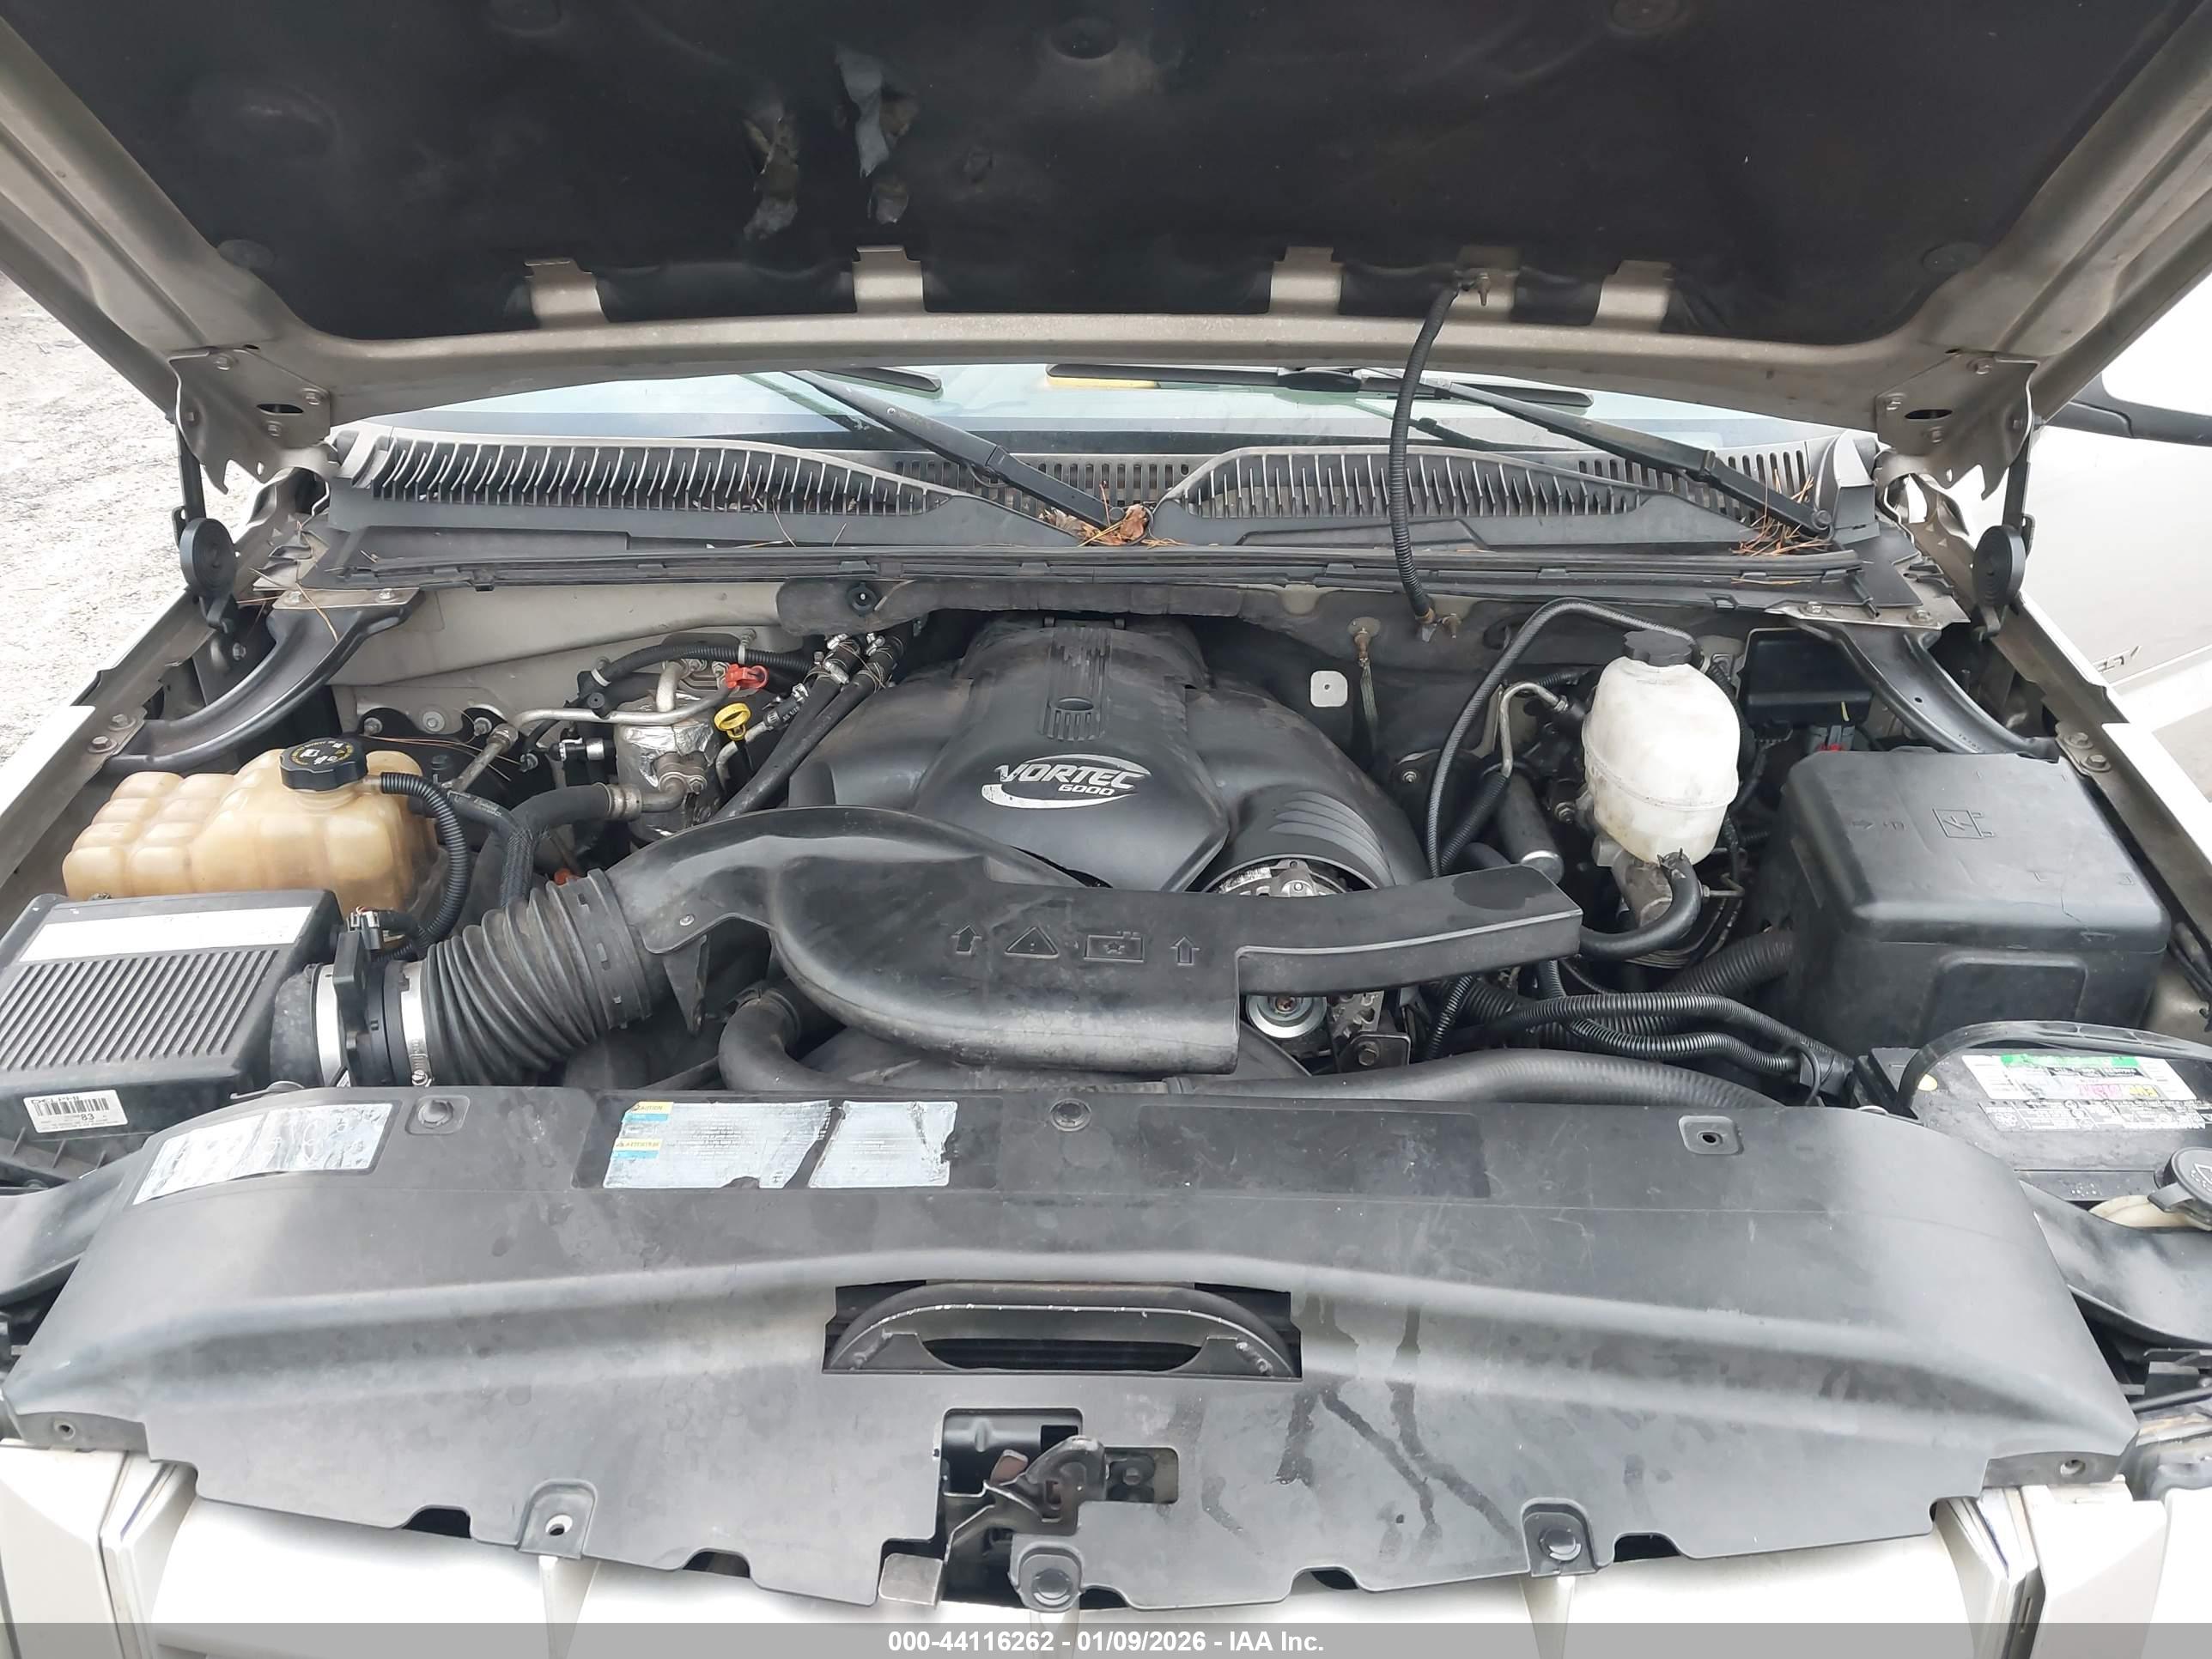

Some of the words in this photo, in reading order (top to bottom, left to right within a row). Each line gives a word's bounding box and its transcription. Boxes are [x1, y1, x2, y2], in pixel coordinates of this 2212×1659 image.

[994, 763, 1144, 790] VORTEC
[1057, 784, 1115, 796] 6000
[81, 1113, 95, 1121] 83
